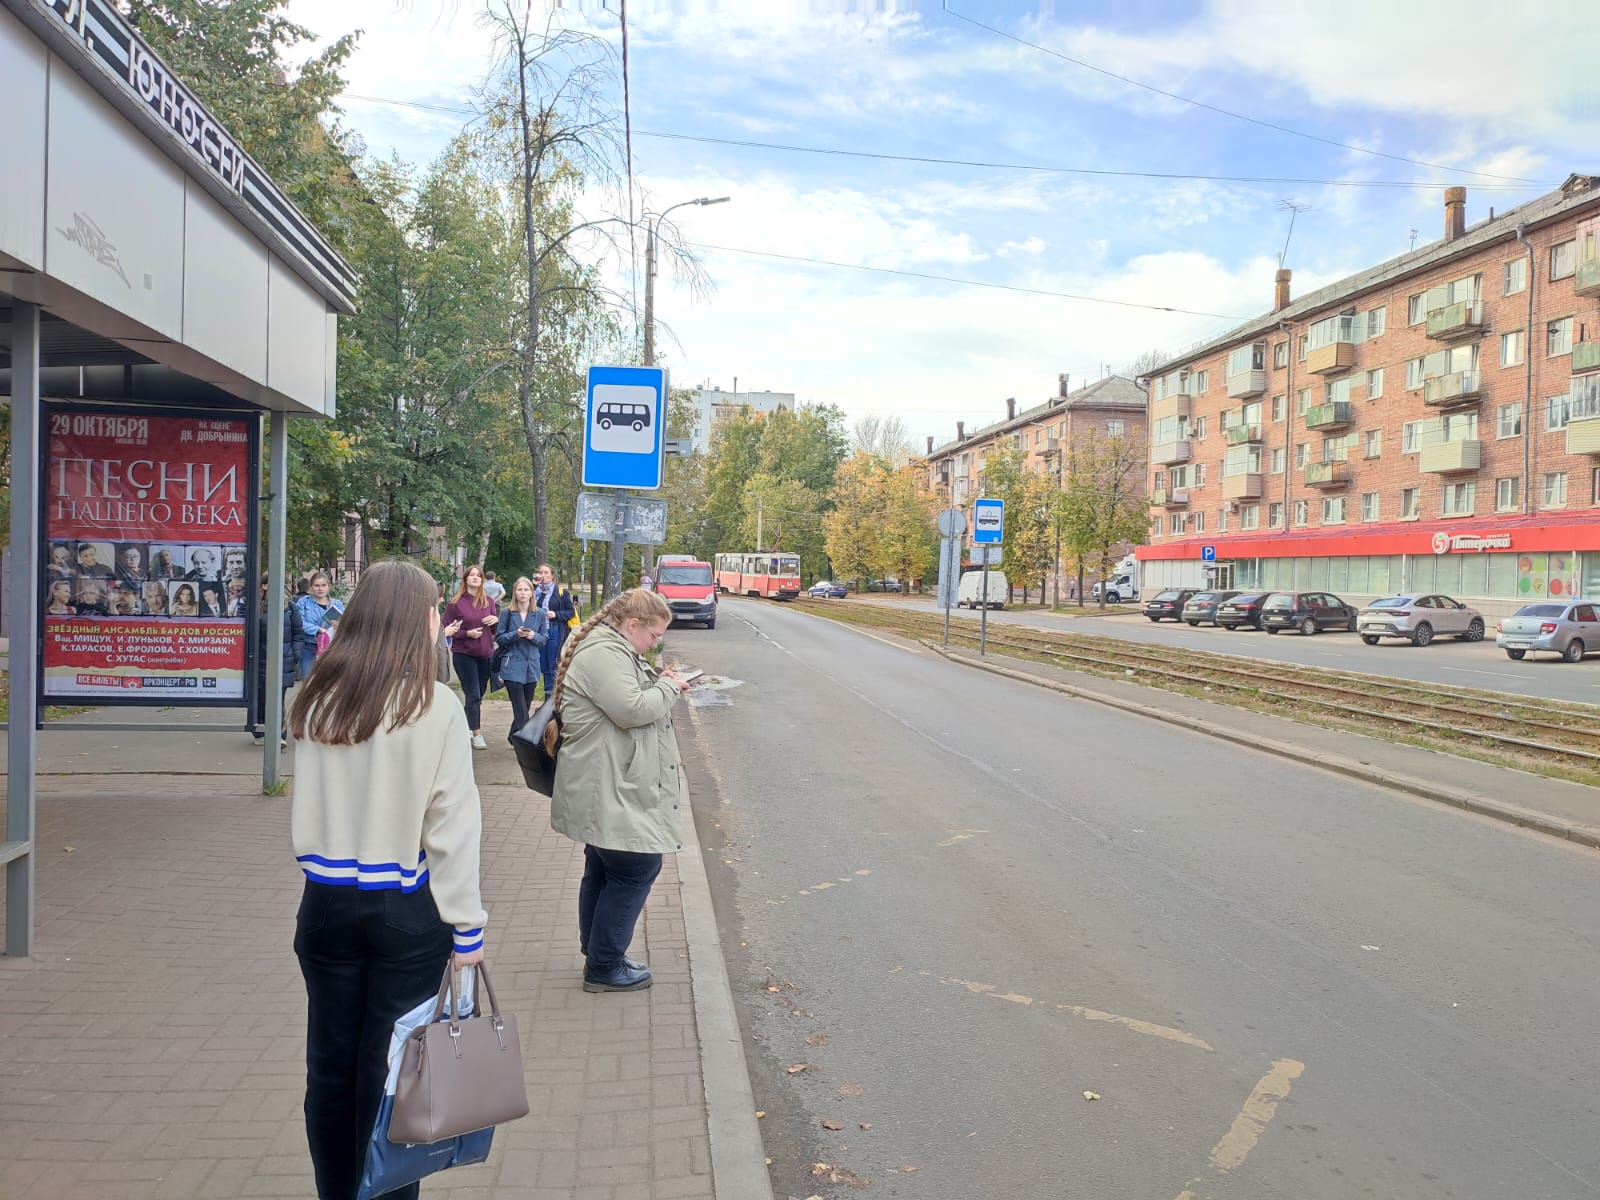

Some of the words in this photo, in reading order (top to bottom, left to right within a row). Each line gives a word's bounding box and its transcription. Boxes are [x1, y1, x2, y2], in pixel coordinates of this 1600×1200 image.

[129, 37, 245, 195] ЮНОСТИ
[51, 414, 70, 435] 29
[73, 415, 148, 438] ОКТЯБРЯ
[198, 420, 208, 430] НА
[210, 421, 232, 431] СЦЕНЕ
[180, 429, 193, 443] ДК
[196, 430, 248, 443] ДОБРЫНИНА
[56, 457, 241, 503] ПЕСНИ
[57, 500, 172, 523] НАШЕГО
[181, 504, 242, 526] ВЕКА
[47, 624, 101, 634] ЗВЁЗДНЫЙ
[103, 626, 158, 635] АНСАМБЛЬ
[161, 627, 200, 635] БАРДОВ
[77, 675, 91, 684] ВСЕ
[91, 676, 119, 685] БИЛЕТЫ
